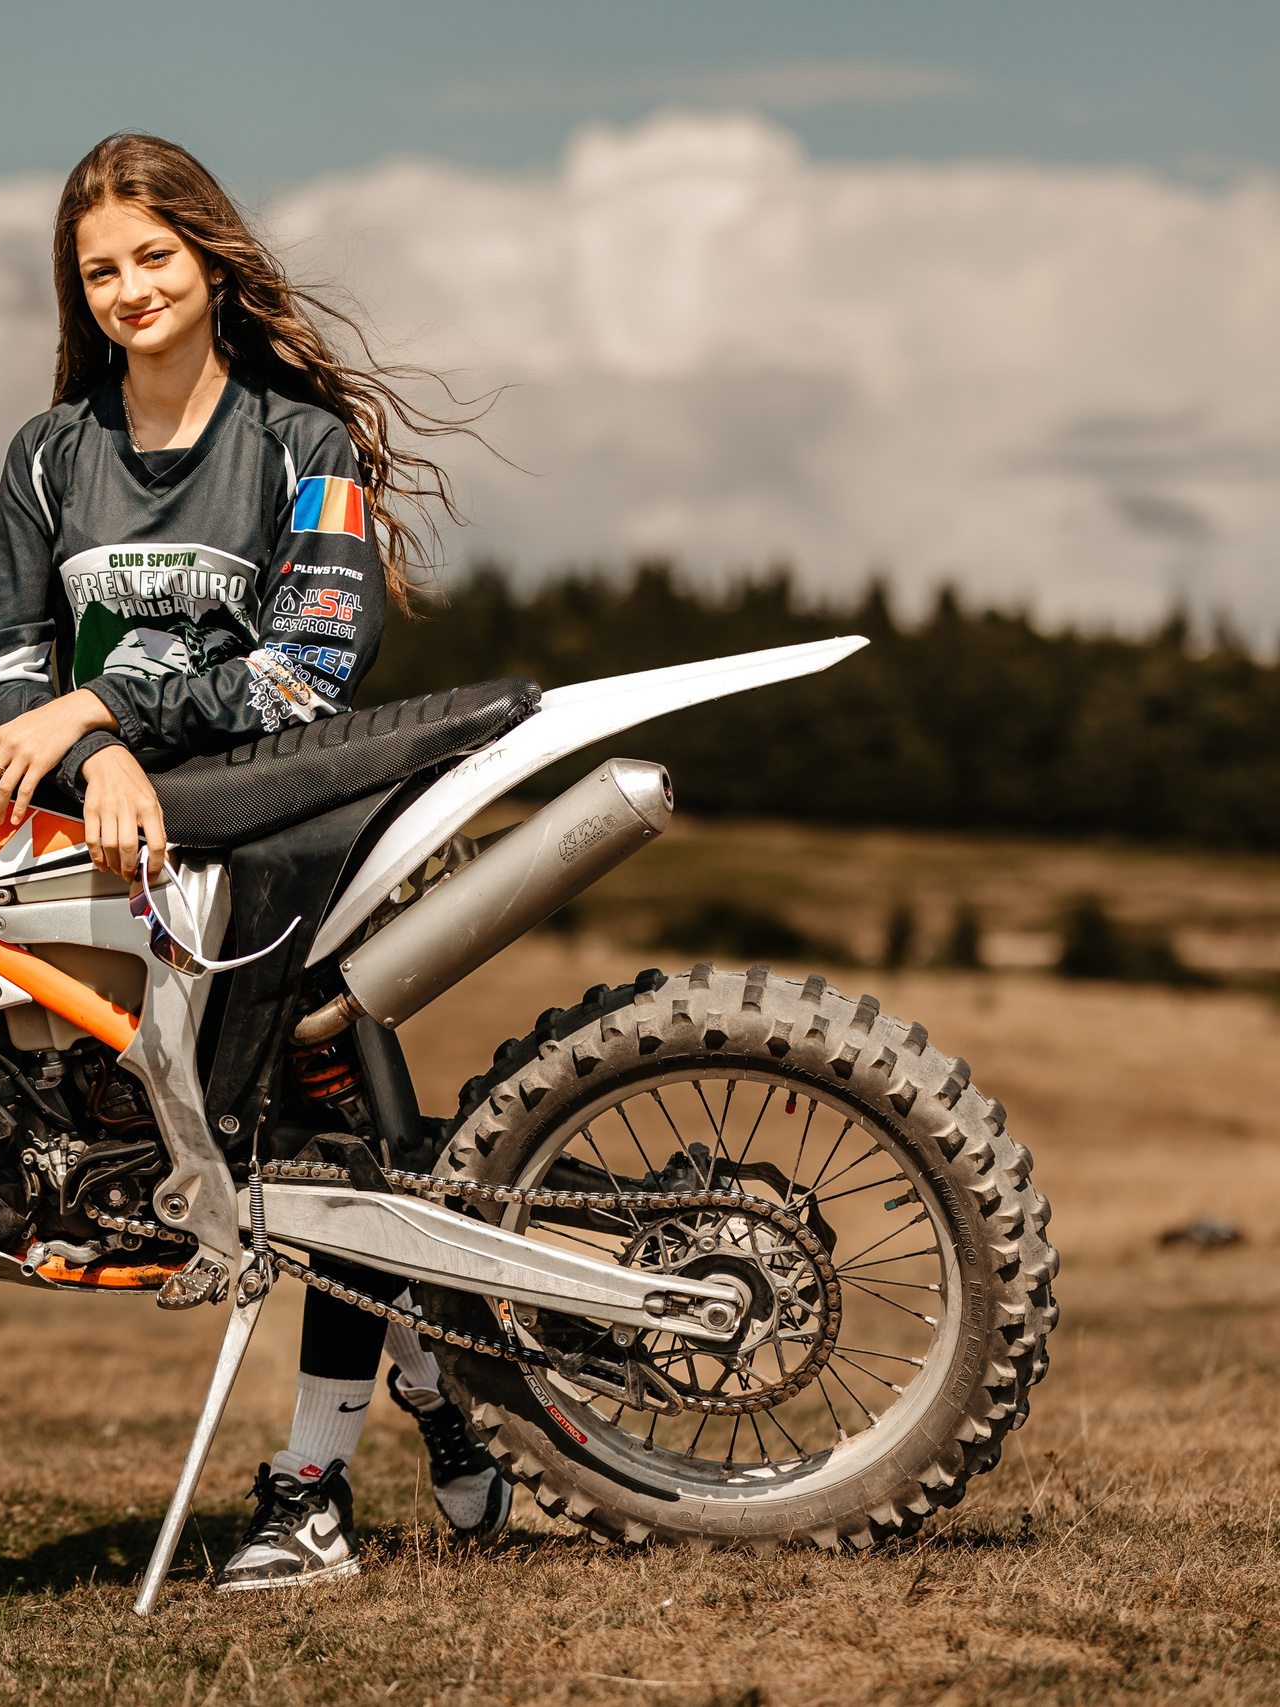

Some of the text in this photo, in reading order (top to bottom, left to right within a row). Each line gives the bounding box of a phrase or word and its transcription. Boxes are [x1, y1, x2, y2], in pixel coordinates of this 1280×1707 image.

[108, 552, 197, 568] CLUB SPORTIV
[67, 569, 247, 605] GREU ENDURO
[119, 595, 196, 619] HOLBAV
[272, 617, 356, 640] GAZ PROIECT
[294, 663, 310, 682] to
[309, 674, 340, 698] you
[558, 814, 603, 857] KTM
[950, 1333, 981, 1399] REAR
[549, 1406, 583, 1443] CONTROL
